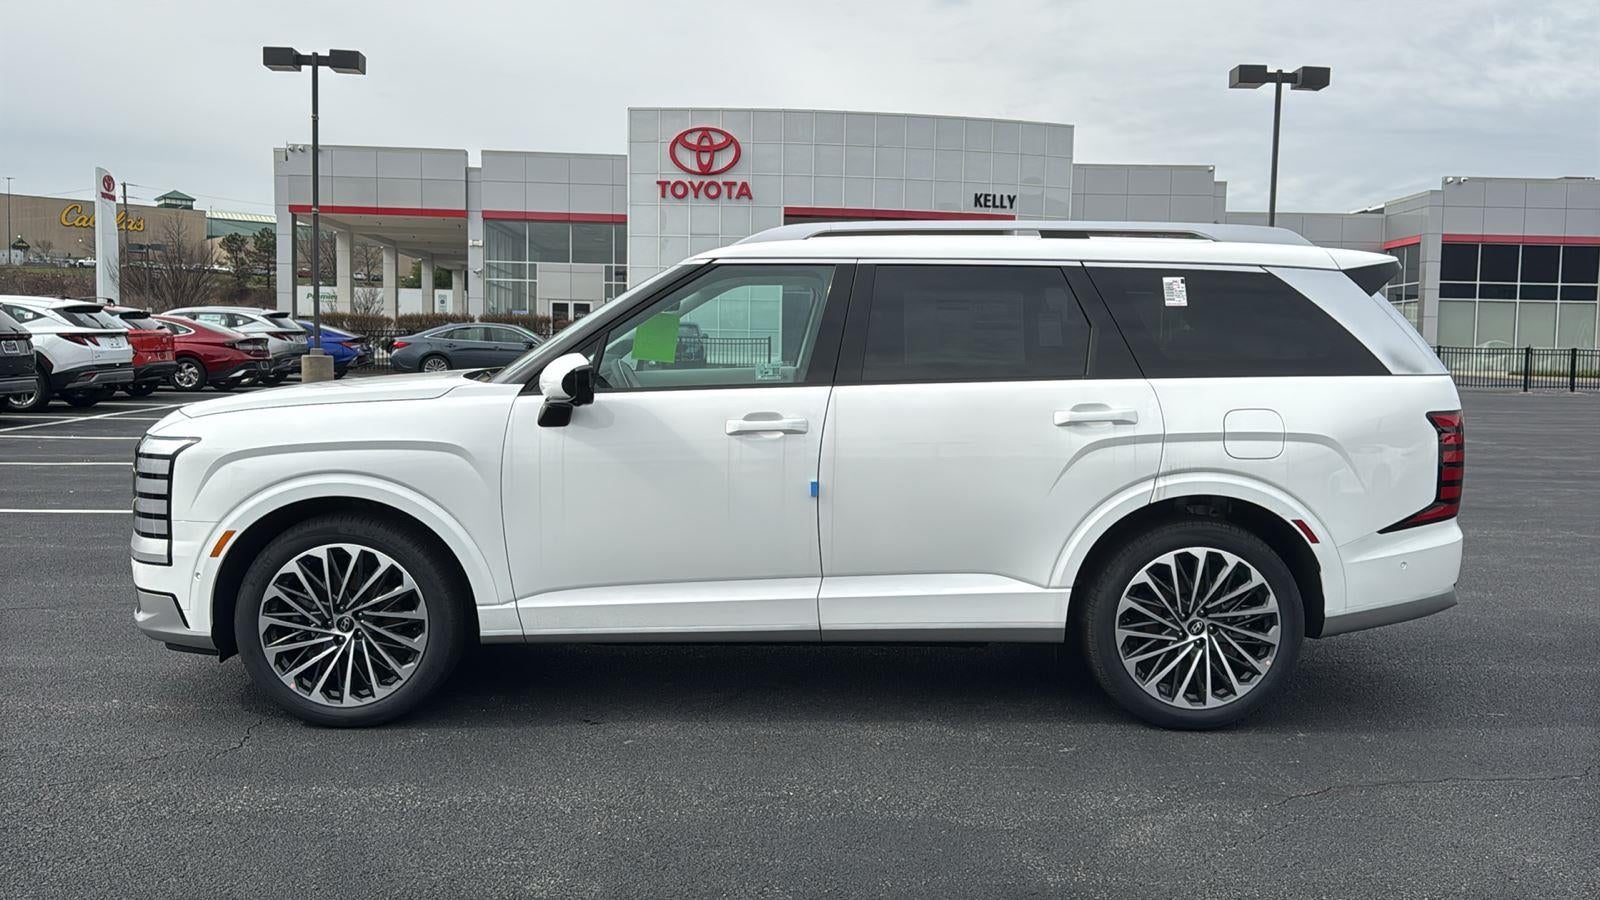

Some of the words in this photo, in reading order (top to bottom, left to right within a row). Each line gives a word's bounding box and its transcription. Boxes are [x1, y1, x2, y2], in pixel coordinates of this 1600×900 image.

[656, 180, 753, 200] TOYOTA
[974, 193, 1017, 209] KELLY
[60, 204, 145, 231] Cala's
